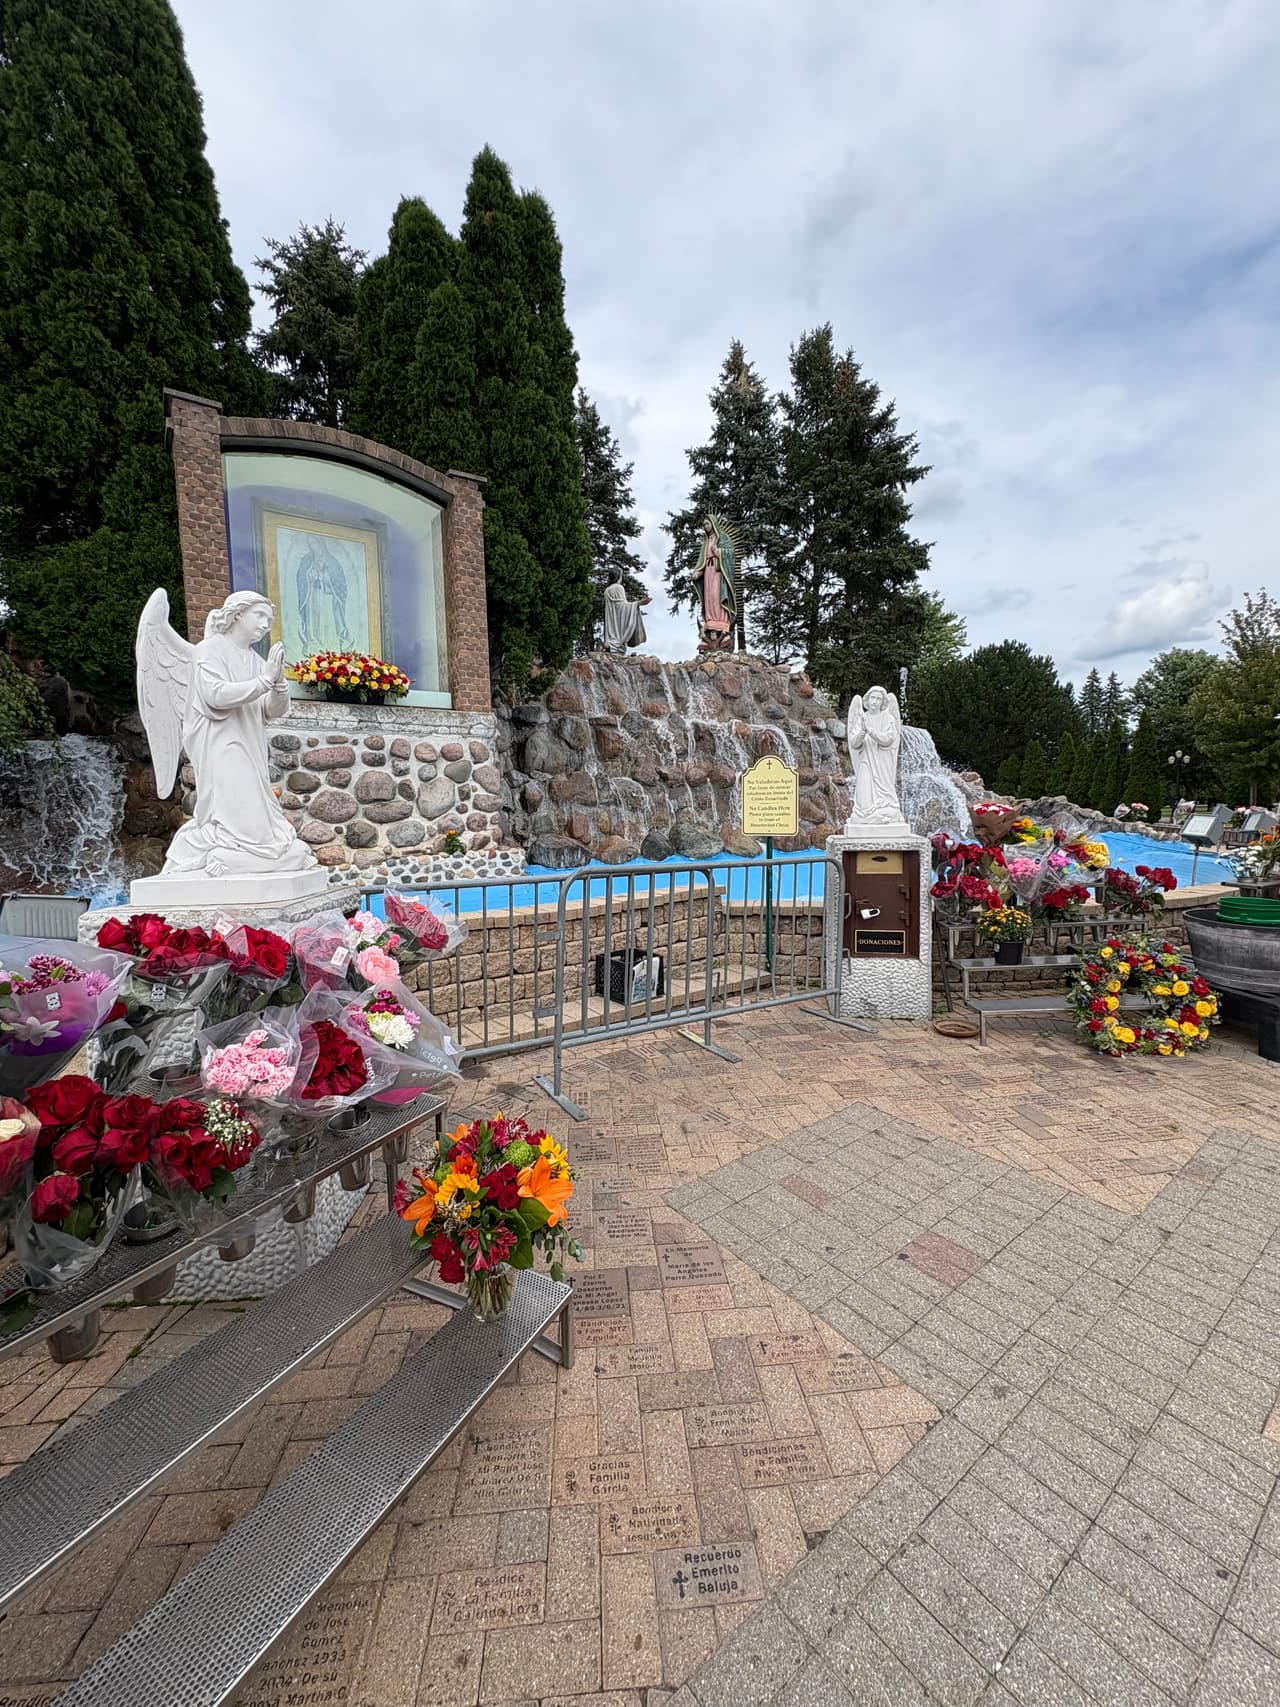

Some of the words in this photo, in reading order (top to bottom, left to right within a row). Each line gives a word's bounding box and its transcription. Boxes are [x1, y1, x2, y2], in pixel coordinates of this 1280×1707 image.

[859, 938, 901, 946] DONACIONES
[589, 1460, 631, 1472] Gracias
[589, 1471, 631, 1483] Familia
[684, 1548, 742, 1564] Recuerdo
[691, 1563, 740, 1579] Emerito
[475, 1573, 526, 1588] Bendice
[698, 1579, 738, 1594] Baluja
[312, 1650, 347, 1666] 1933
